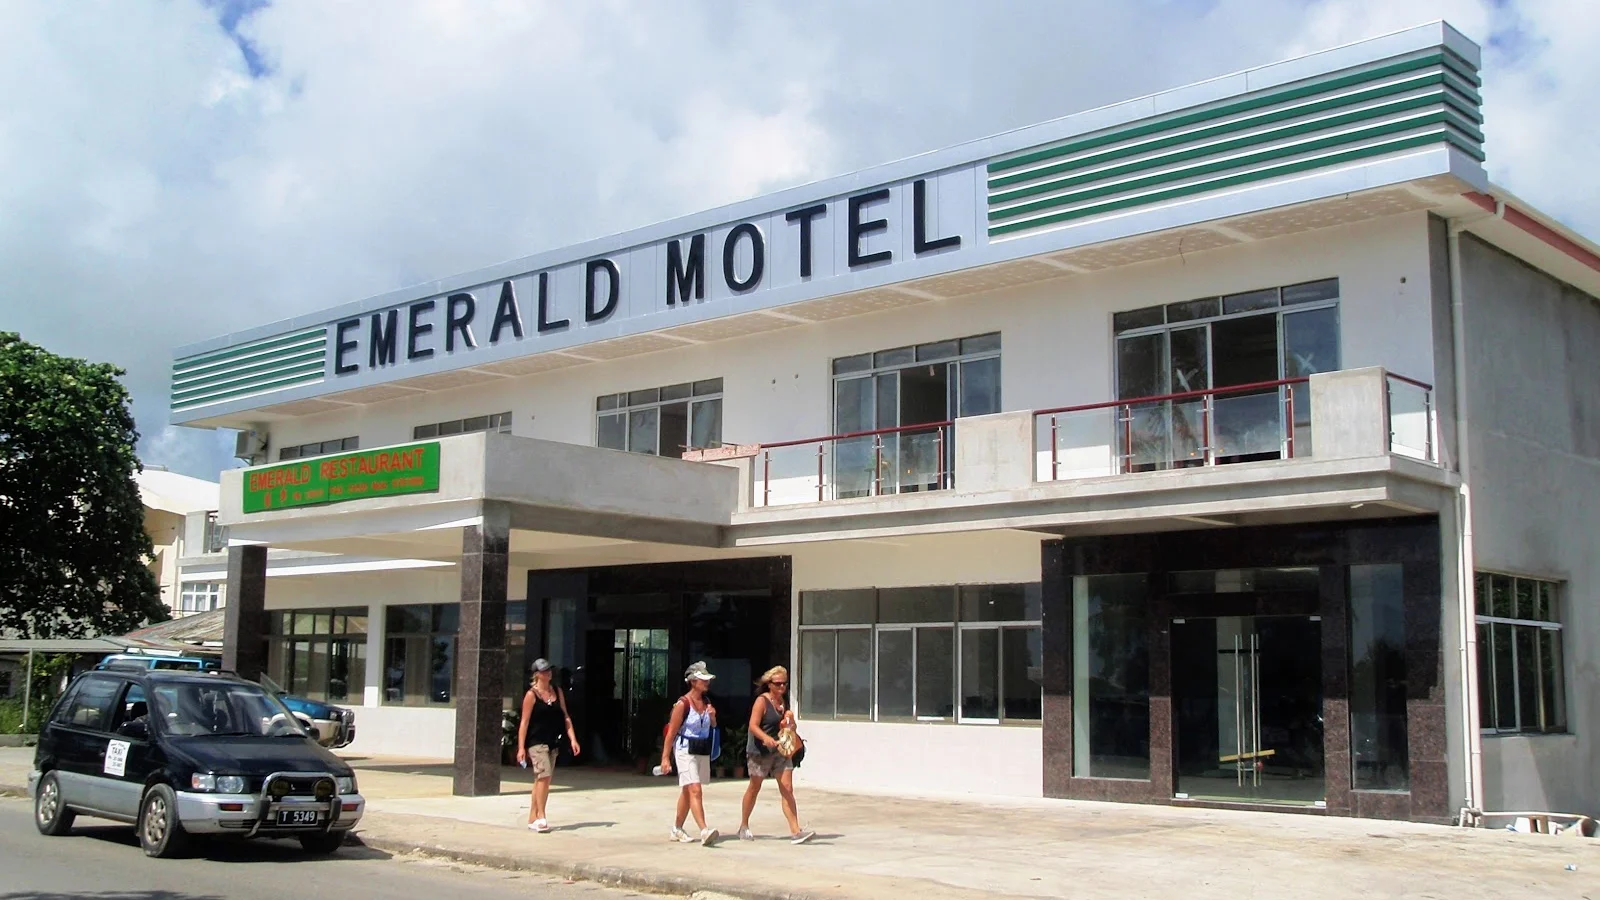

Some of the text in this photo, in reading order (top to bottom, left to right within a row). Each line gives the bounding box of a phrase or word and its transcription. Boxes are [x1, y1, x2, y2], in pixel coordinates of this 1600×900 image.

[335, 179, 961, 374] EMERALD MOTEL
[250, 448, 424, 492] EMERALD RESTAURANT
[112, 747, 122, 755] TAXI
[282, 811, 315, 822] T 5349
